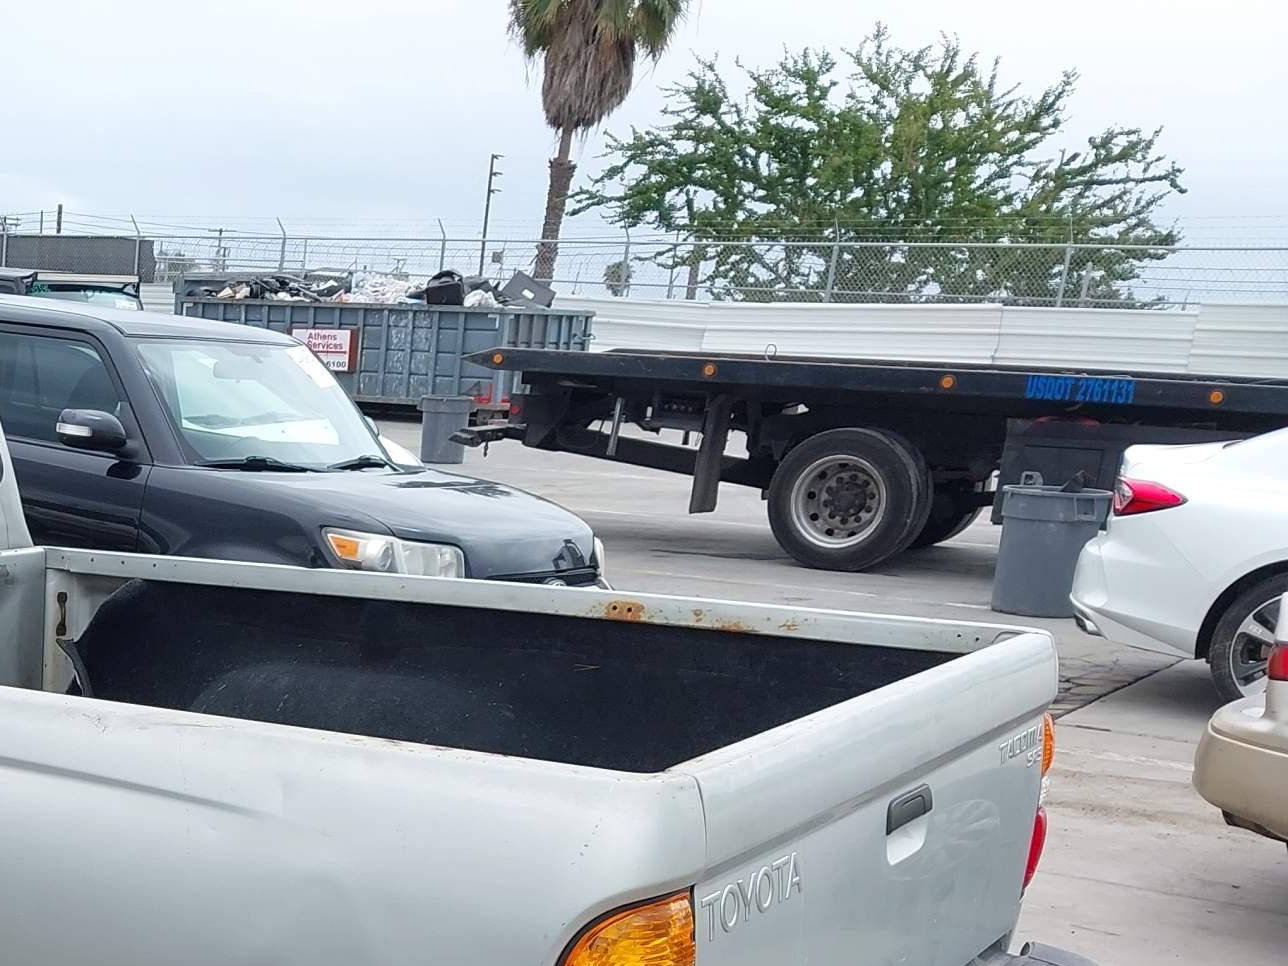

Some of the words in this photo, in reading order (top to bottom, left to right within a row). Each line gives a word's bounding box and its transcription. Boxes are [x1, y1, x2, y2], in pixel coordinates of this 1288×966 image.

[306, 341, 344, 350] Services
[307, 332, 337, 341] Athens
[1026, 375, 1075, 400] USDOT
[1076, 378, 1136, 404] 2761131
[700, 852, 800, 942] TOYOTA
